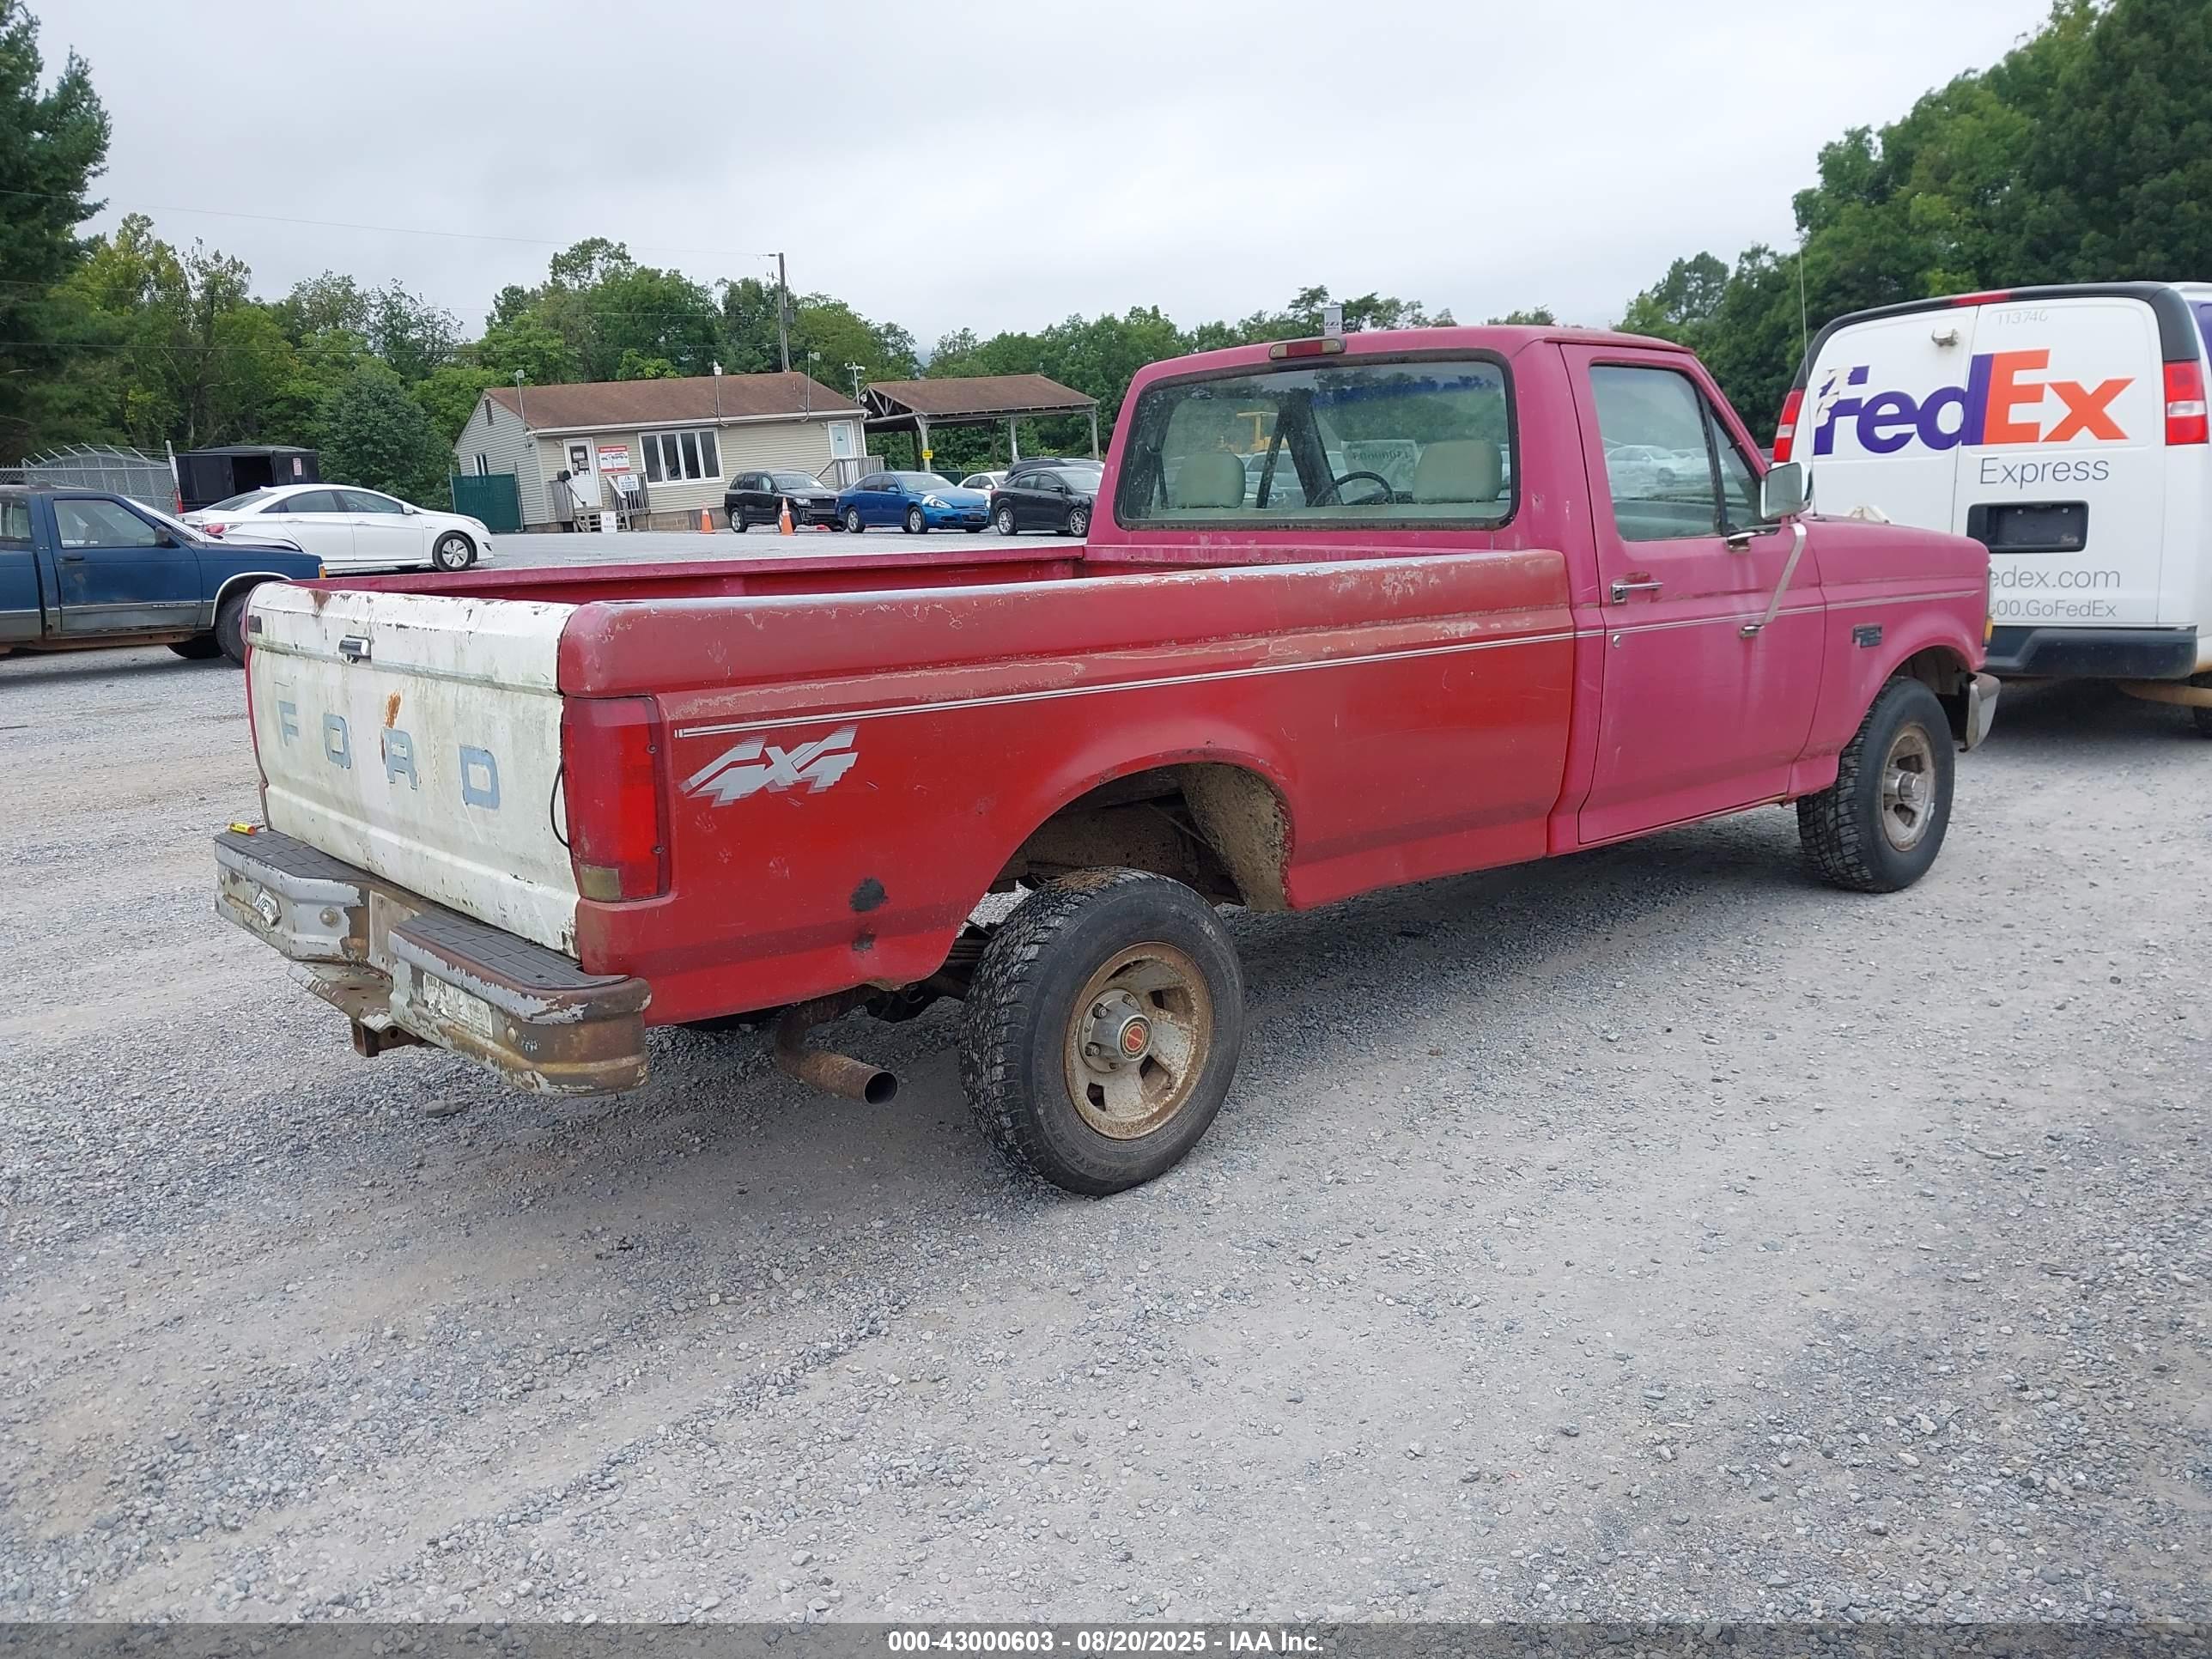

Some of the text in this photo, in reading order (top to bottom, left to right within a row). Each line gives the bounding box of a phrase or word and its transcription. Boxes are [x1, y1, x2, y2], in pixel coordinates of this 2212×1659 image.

[1979, 457, 2111, 489] Express
[1990, 565, 2121, 589] edex.com
[278, 699, 501, 810] FORD
